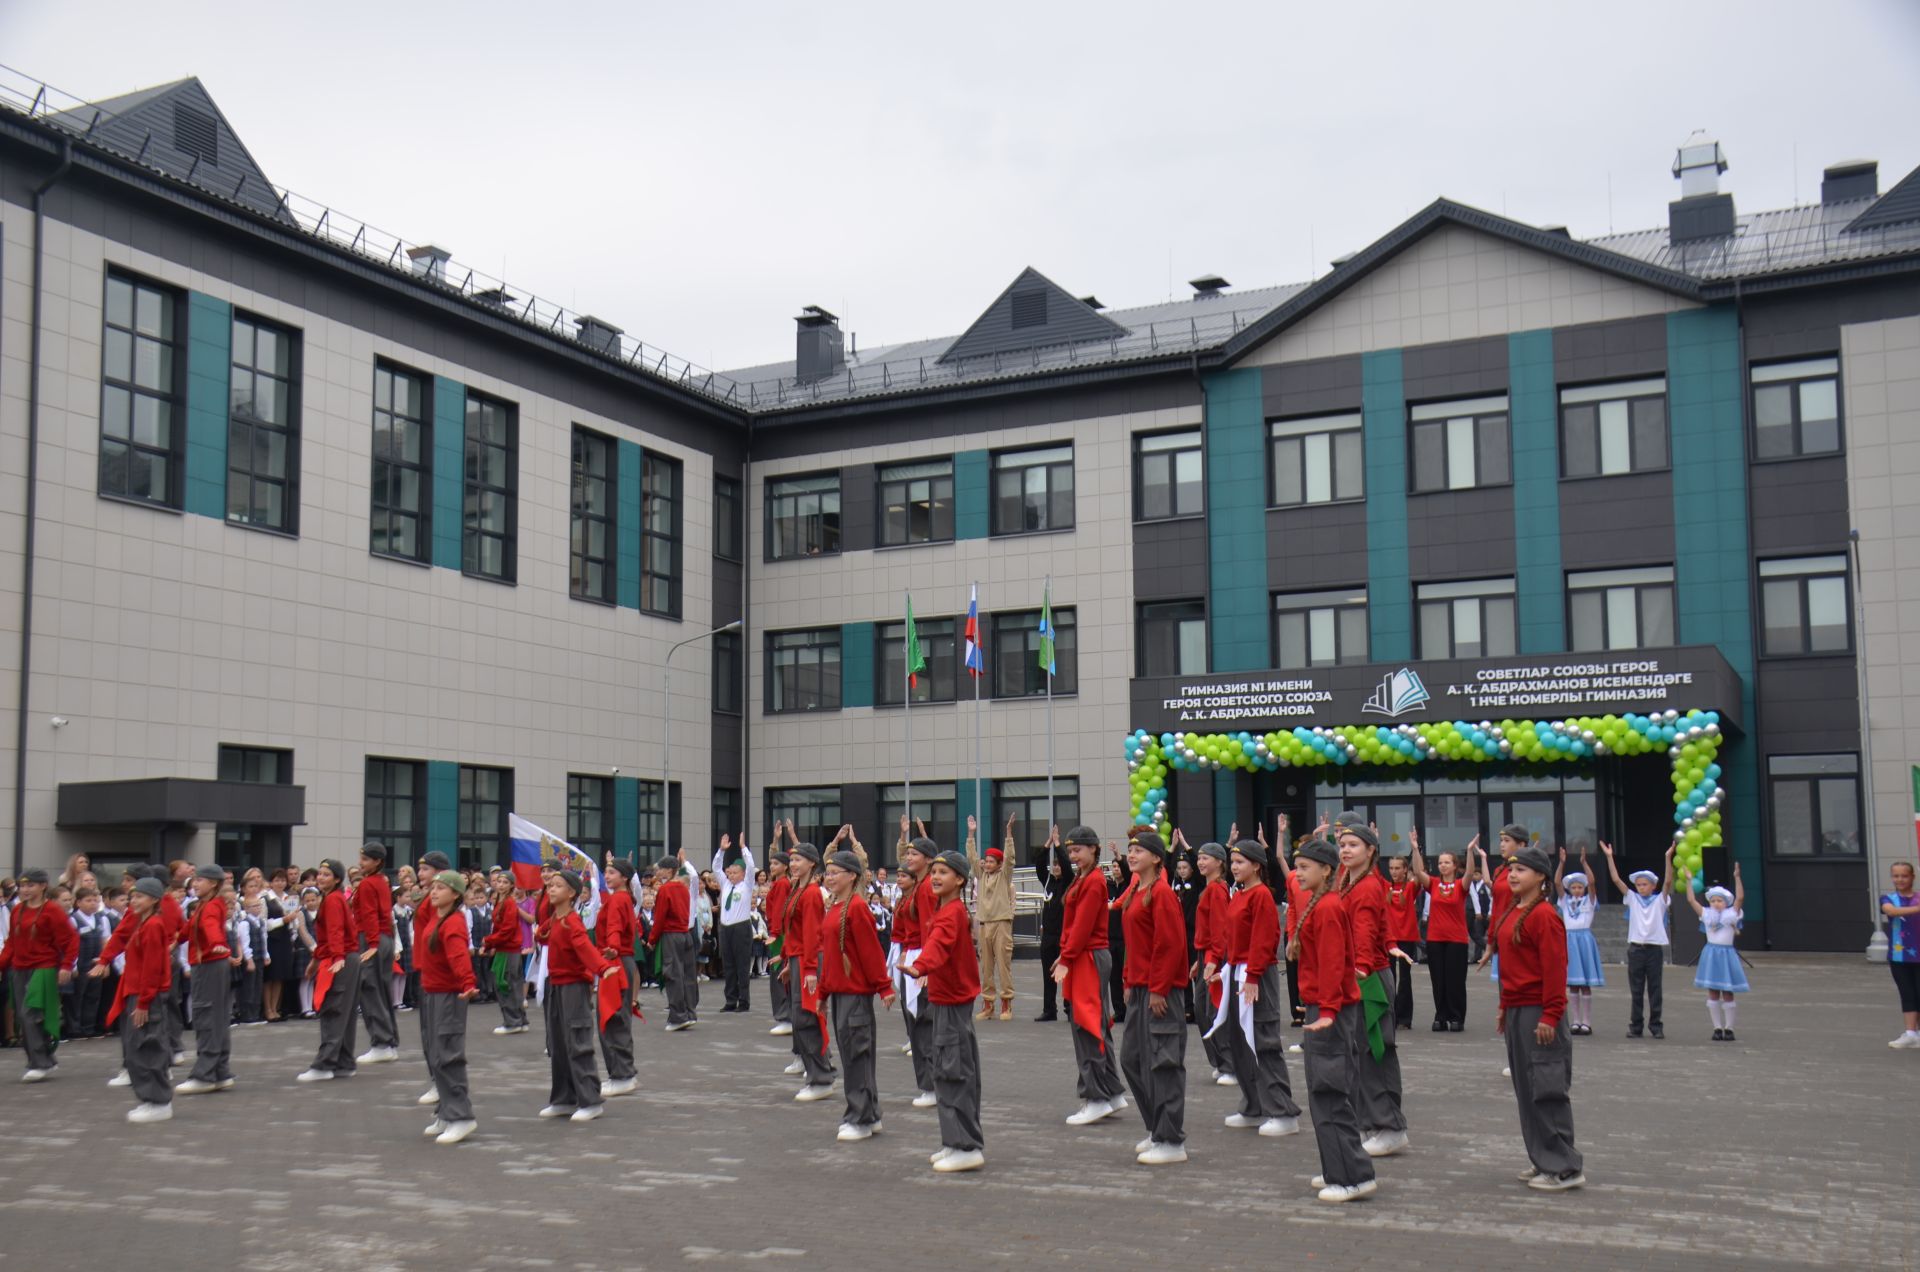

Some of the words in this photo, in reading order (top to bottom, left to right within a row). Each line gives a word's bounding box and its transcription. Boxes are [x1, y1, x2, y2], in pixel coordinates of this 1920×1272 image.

[1476, 668, 1550, 681] СОВЕТЛАР
[1552, 664, 1609, 677] СОЮЗЫ
[1612, 661, 1658, 673] ГЕРОЕ
[1181, 683, 1248, 696] ГИМНАЗИЯ
[1267, 680, 1313, 691] ИМЕНИ
[1447, 685, 1461, 695] А.
[1463, 684, 1477, 694] К.
[1480, 678, 1589, 694] АБДРАХМАНОВ
[1592, 673, 1692, 688] ИСЕМЕНДӘГЕ
[1163, 699, 1201, 709] ГЕРОЯ
[1203, 693, 1283, 707] СОВЕТСКОГО
[1285, 691, 1332, 703] СОЮЗА
[1470, 697, 1476, 707] 1
[1478, 696, 1507, 706] НЧЕ
[1509, 692, 1583, 705] НОМЕРЛЫ
[1585, 688, 1667, 702] ГИМНАЗИЯ
[1180, 711, 1193, 720] А.
[1195, 709, 1207, 719] К.
[1209, 704, 1315, 720] АБДРАХМАНОВА
